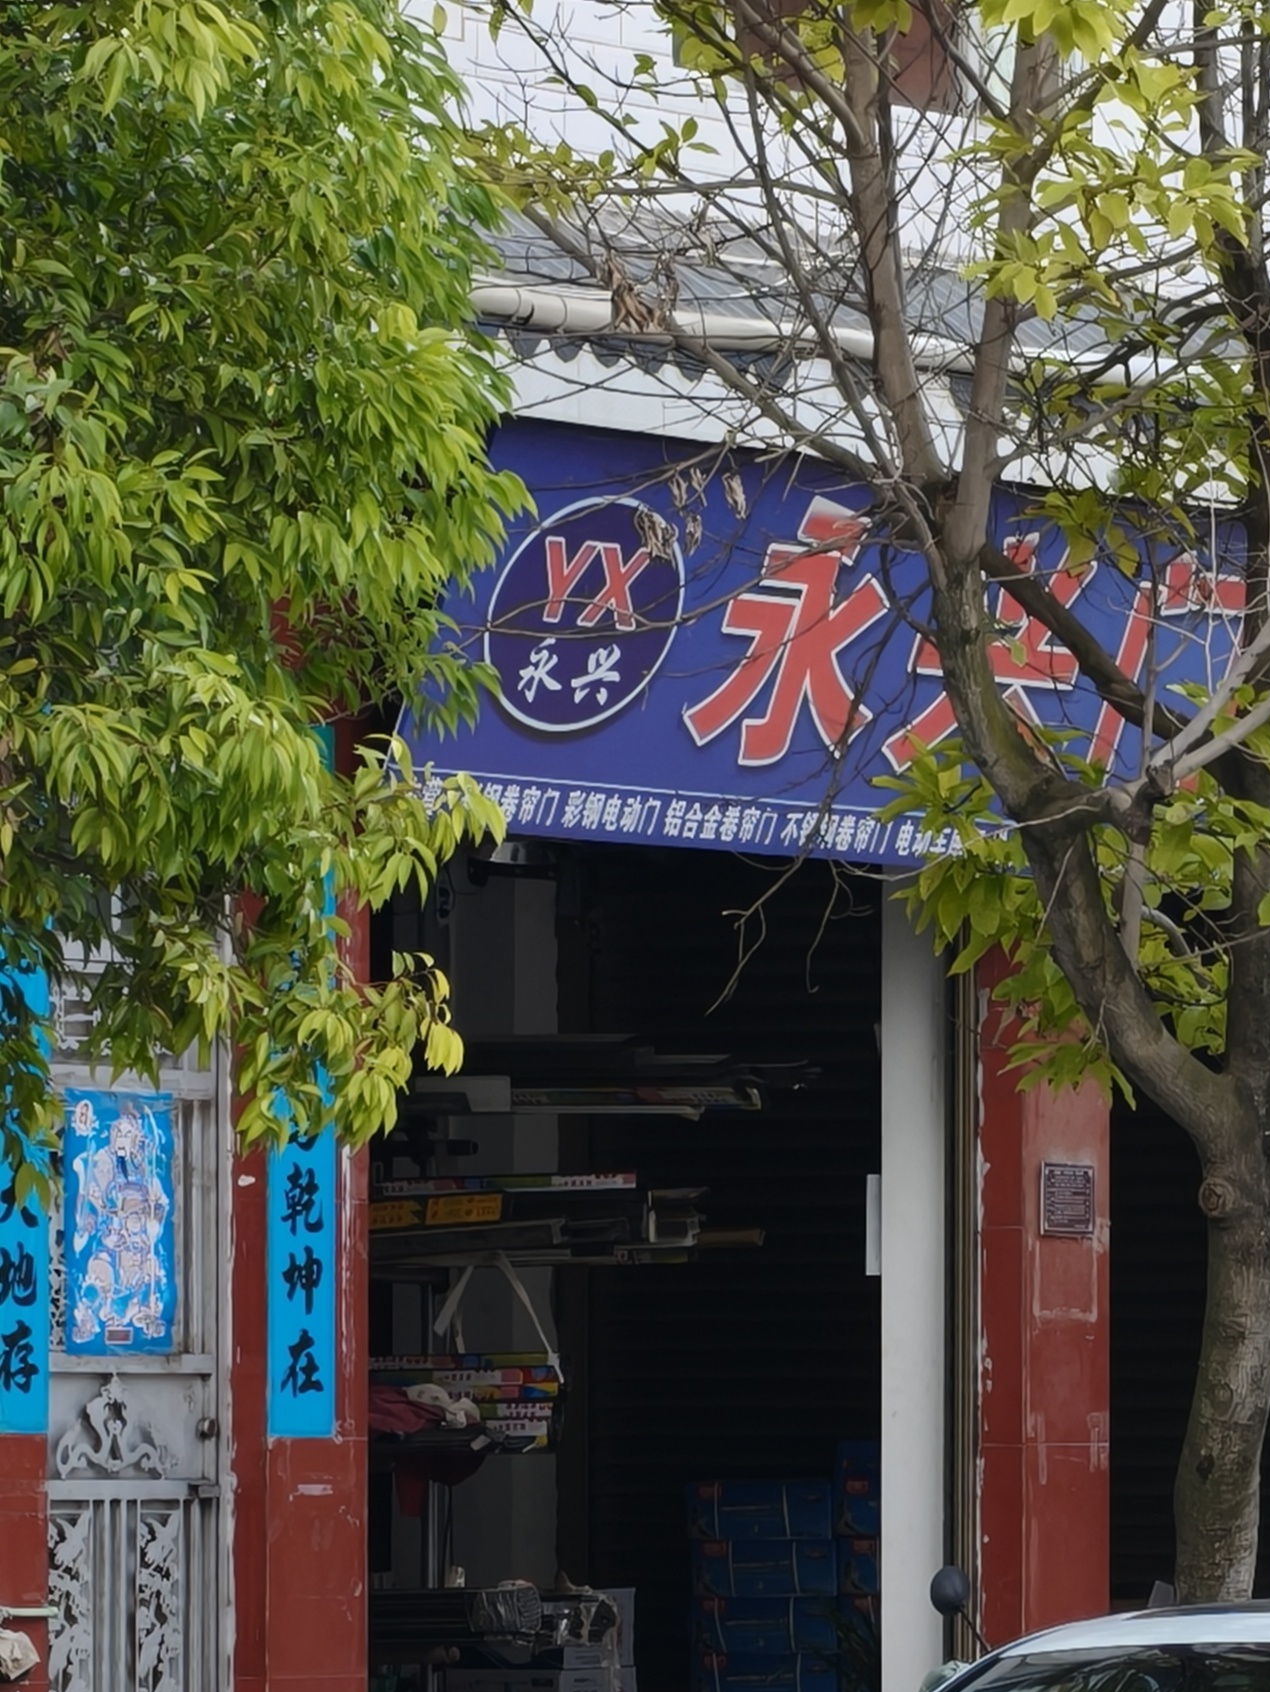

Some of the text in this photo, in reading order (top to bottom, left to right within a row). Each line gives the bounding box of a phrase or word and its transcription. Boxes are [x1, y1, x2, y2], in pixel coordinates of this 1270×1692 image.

[545, 536, 651, 631] YX
[517, 637, 621, 706] 永兴
[463, 780, 560, 826] 钢卷帘门
[561, 790, 661, 836] 彩钢电动门
[663, 798, 779, 846] 铝合金卷帘门
[895, 820, 984, 860] 电动车库
[280, 1122, 325, 1399] 乾坤在
